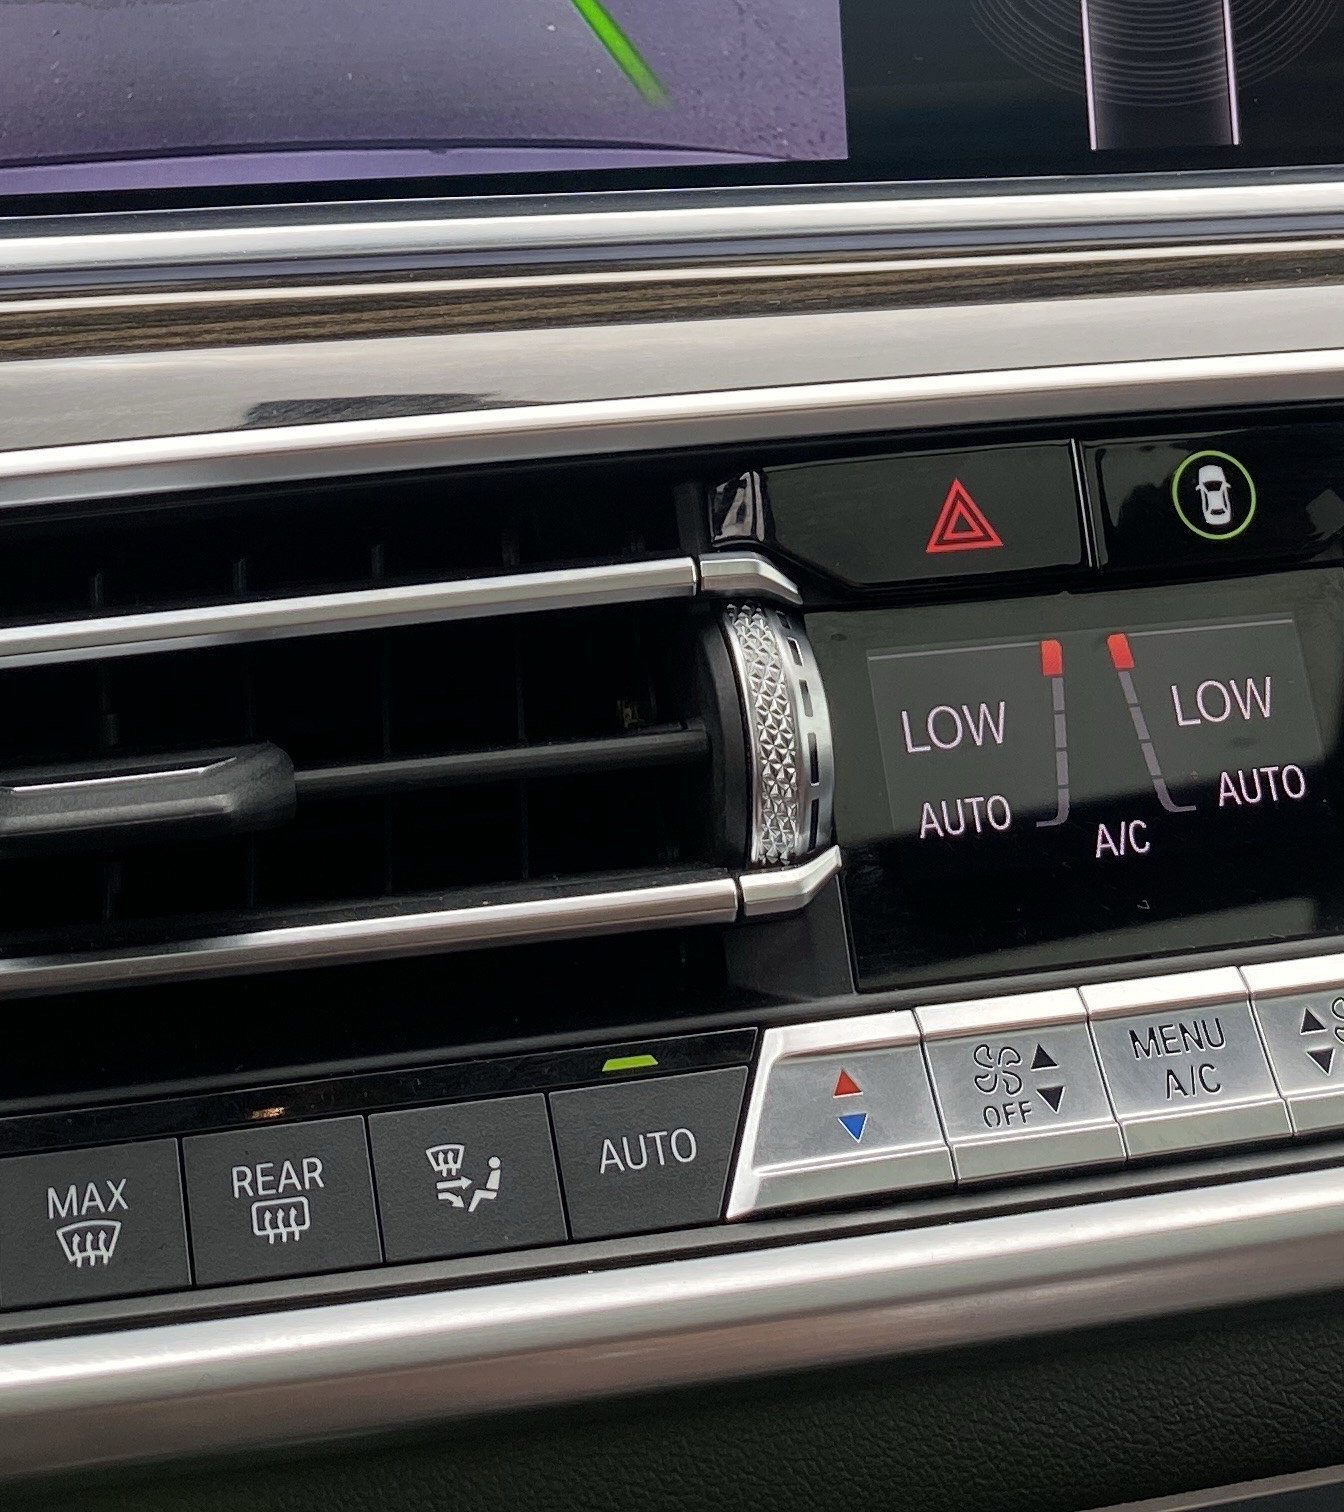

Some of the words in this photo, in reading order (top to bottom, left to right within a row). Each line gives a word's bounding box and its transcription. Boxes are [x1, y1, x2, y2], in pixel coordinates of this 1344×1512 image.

[1170, 675, 1273, 726] LOW
[900, 700, 1007, 753] LOW
[1218, 764, 1306, 808] AUTO
[919, 794, 1012, 839] AUTO
[1094, 819, 1151, 859] A/C
[1130, 1018, 1226, 1059] MENU
[1164, 1064, 1221, 1099] A/C
[983, 1101, 1033, 1129] OFF
[598, 1127, 698, 1176] AUTO
[47, 1178, 129, 1219] MAX
[231, 1156, 325, 1199] REAR
